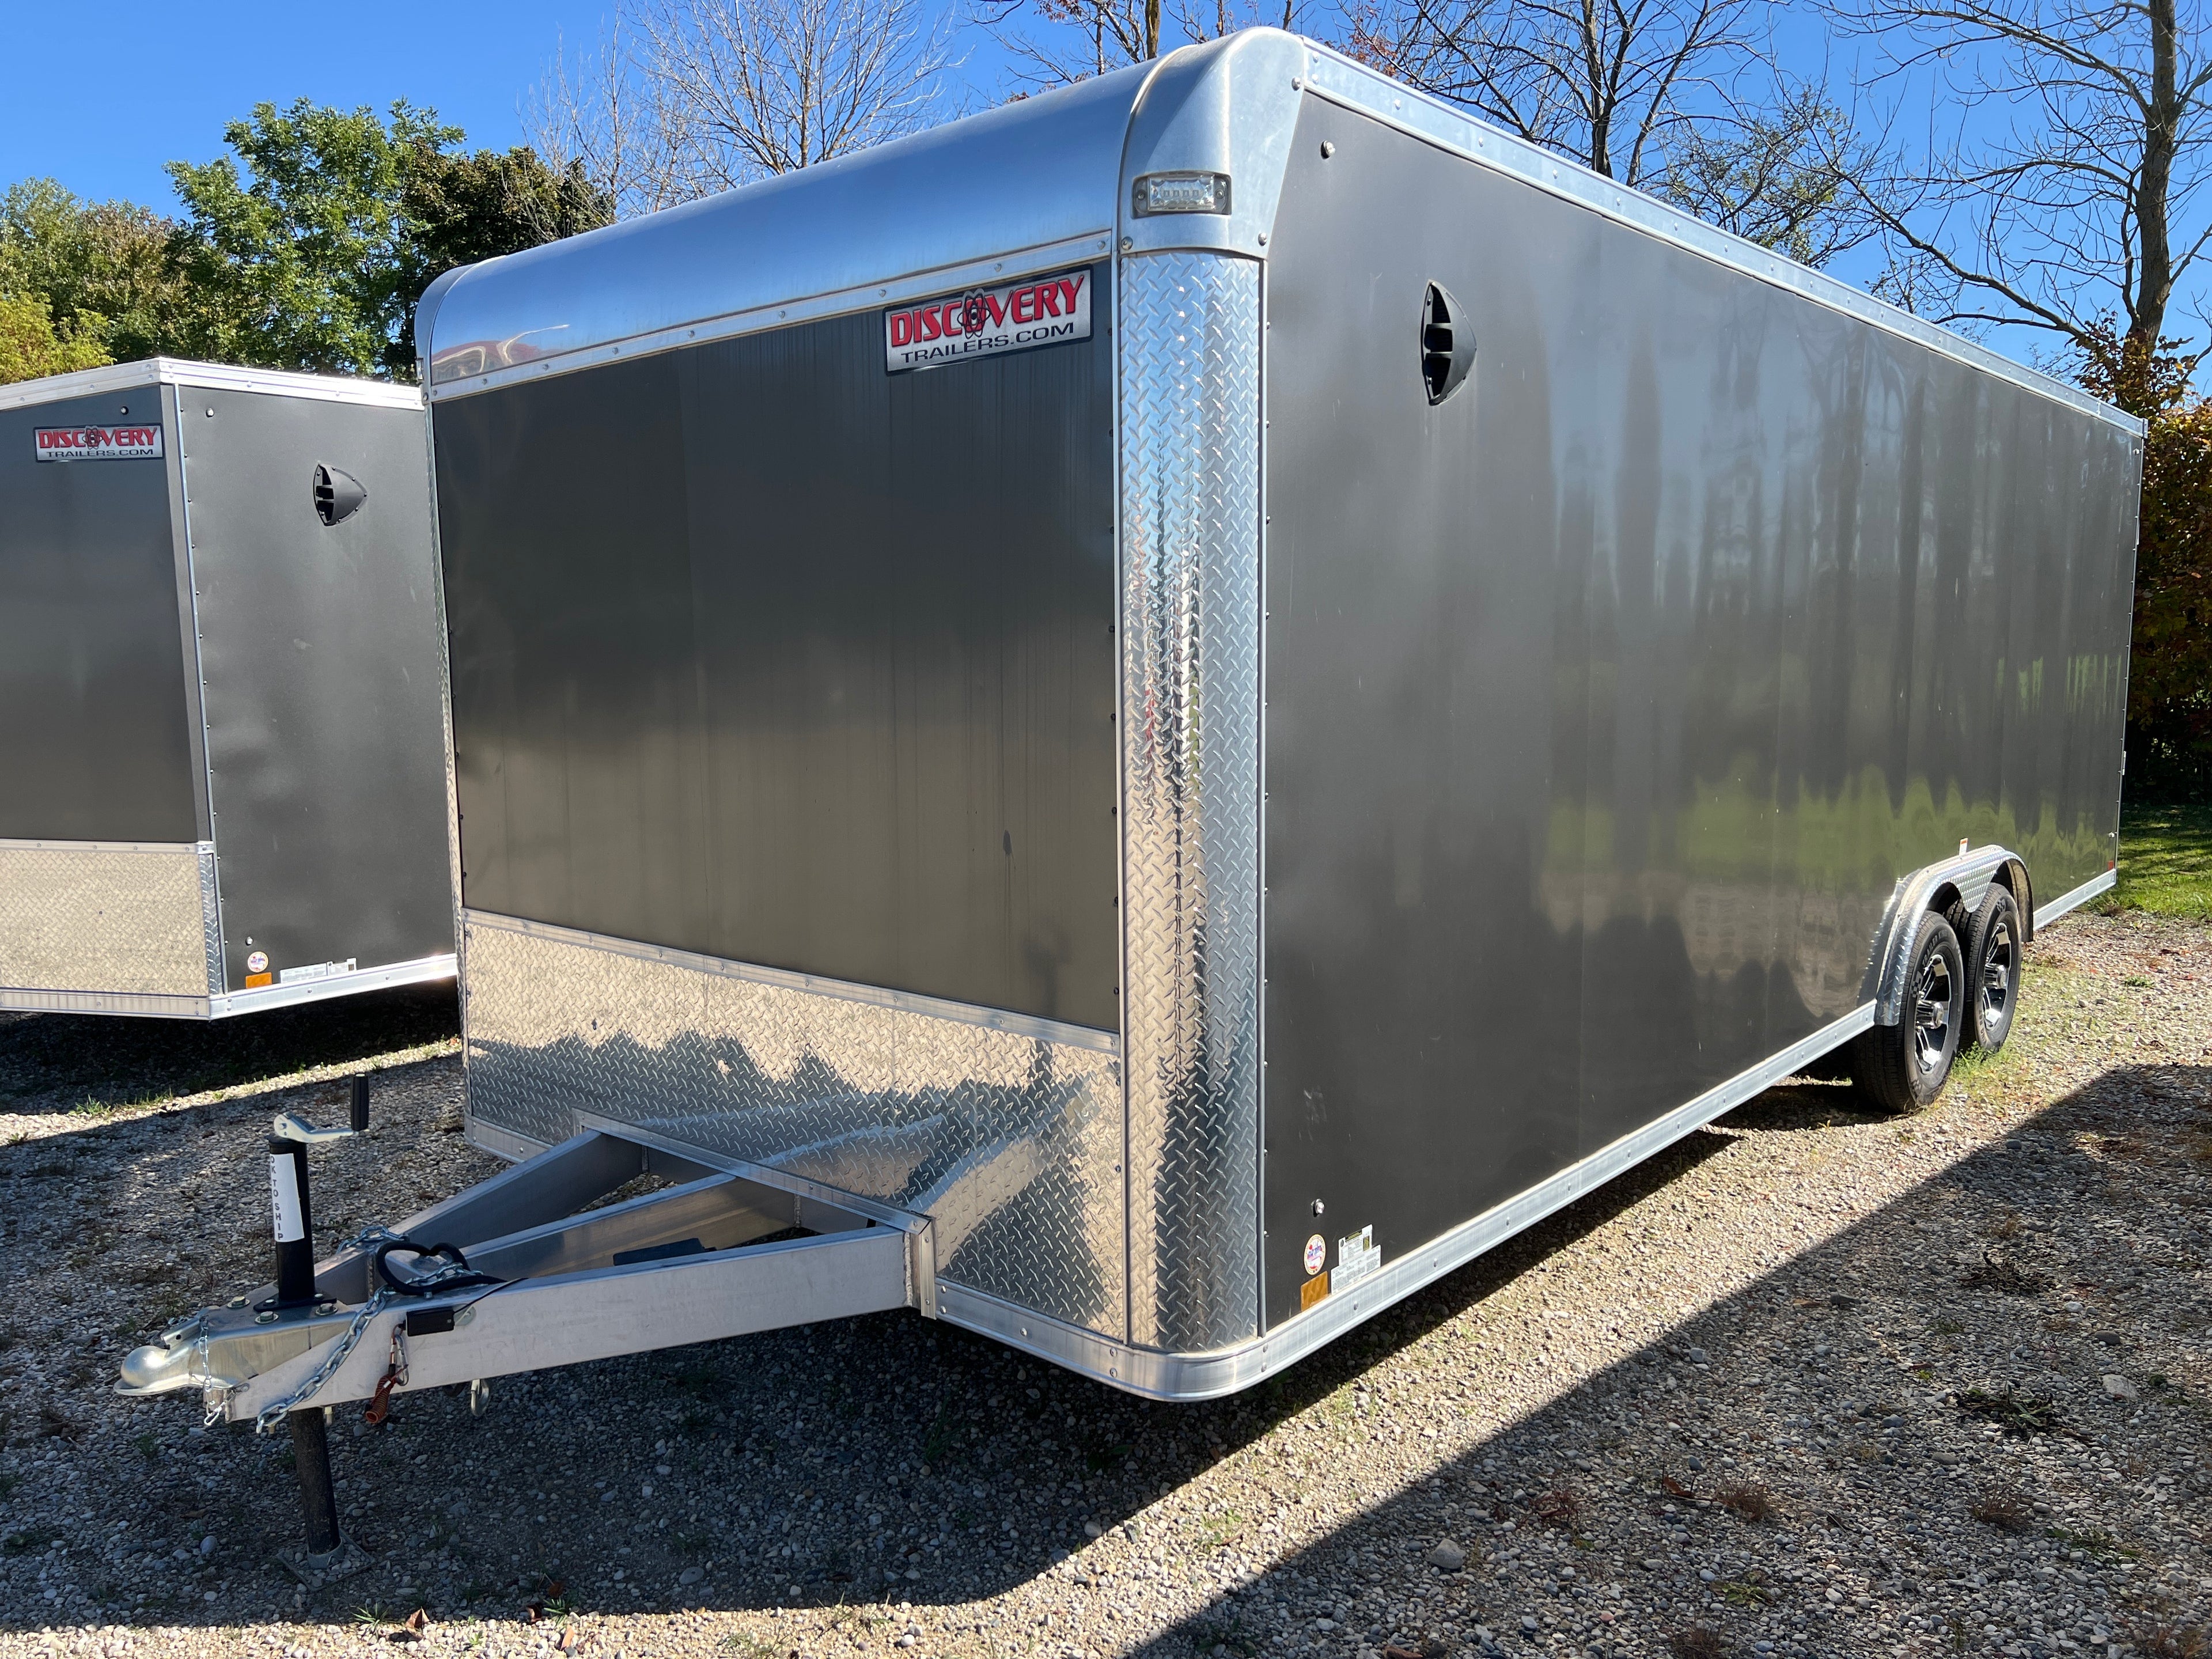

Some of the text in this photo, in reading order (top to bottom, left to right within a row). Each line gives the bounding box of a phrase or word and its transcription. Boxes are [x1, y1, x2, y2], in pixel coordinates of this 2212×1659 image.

[891, 275, 1084, 347] DISCOVERY
[900, 321, 1074, 363] TRAILERS.COM
[38, 427, 157, 448] DISCOVERY
[47, 449, 154, 457] TRAILERS.COM
[270, 1156, 283, 1240] OK TO SHIP
